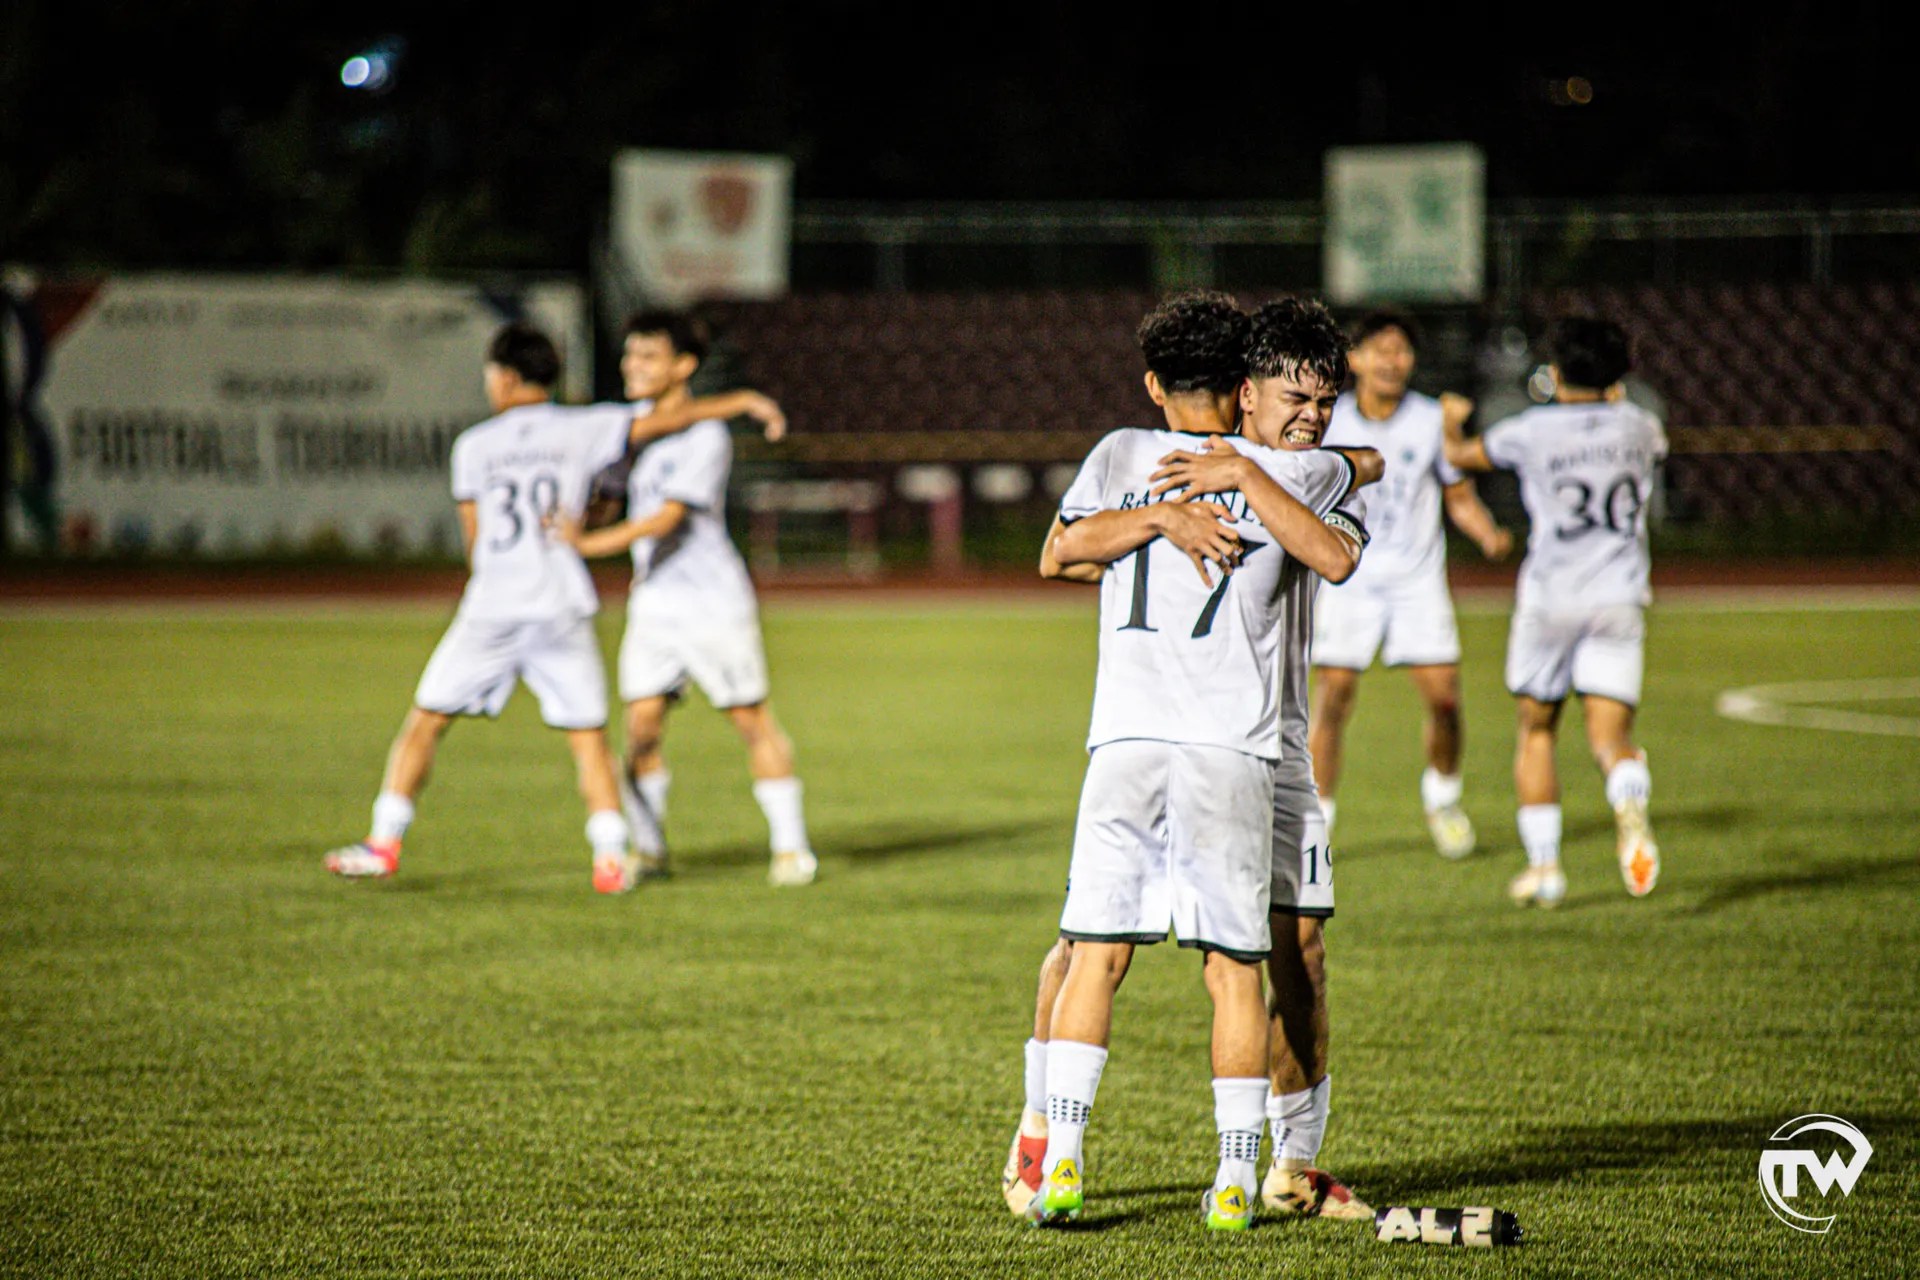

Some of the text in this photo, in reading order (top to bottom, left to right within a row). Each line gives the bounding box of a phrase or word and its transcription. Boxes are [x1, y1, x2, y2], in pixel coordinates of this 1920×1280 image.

[484, 473, 560, 554] 30
[1551, 470, 1642, 543] 30
[1116, 534, 1269, 639] 17
